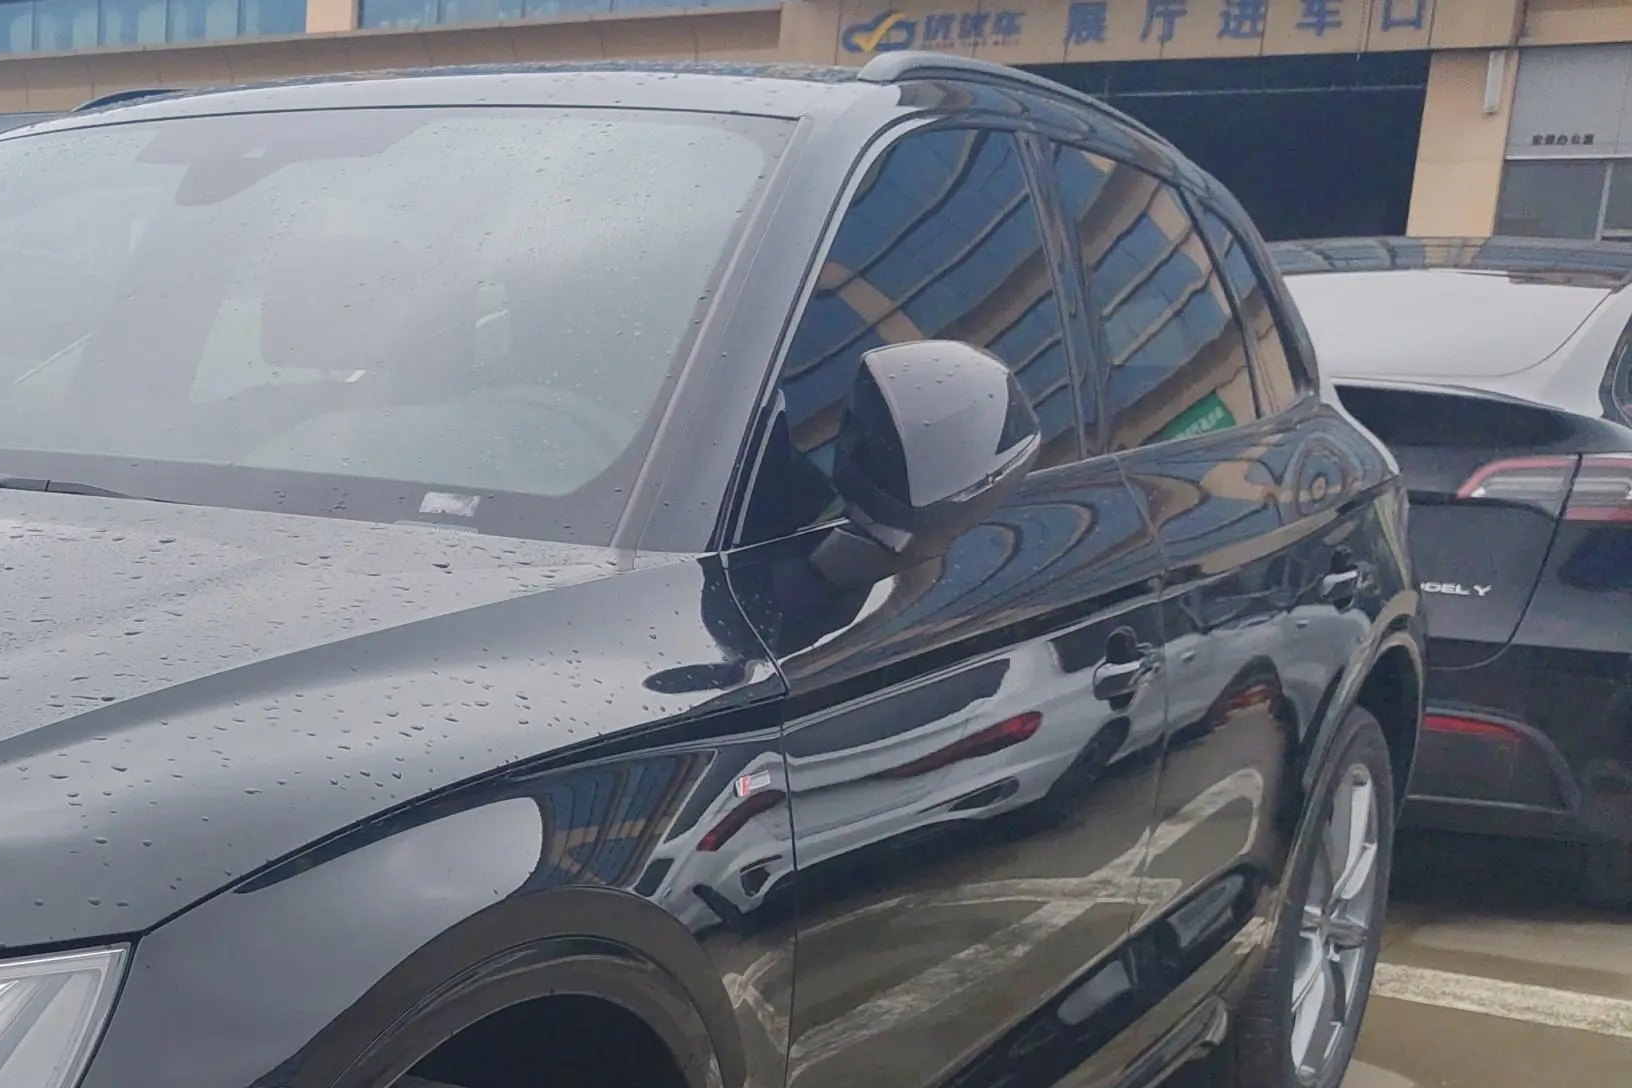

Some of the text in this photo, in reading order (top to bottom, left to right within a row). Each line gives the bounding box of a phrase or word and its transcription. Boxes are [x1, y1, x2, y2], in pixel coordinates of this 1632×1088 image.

[1065, 0, 1423, 45] 展厅进车口
[1420, 581, 1470, 596] DEL
